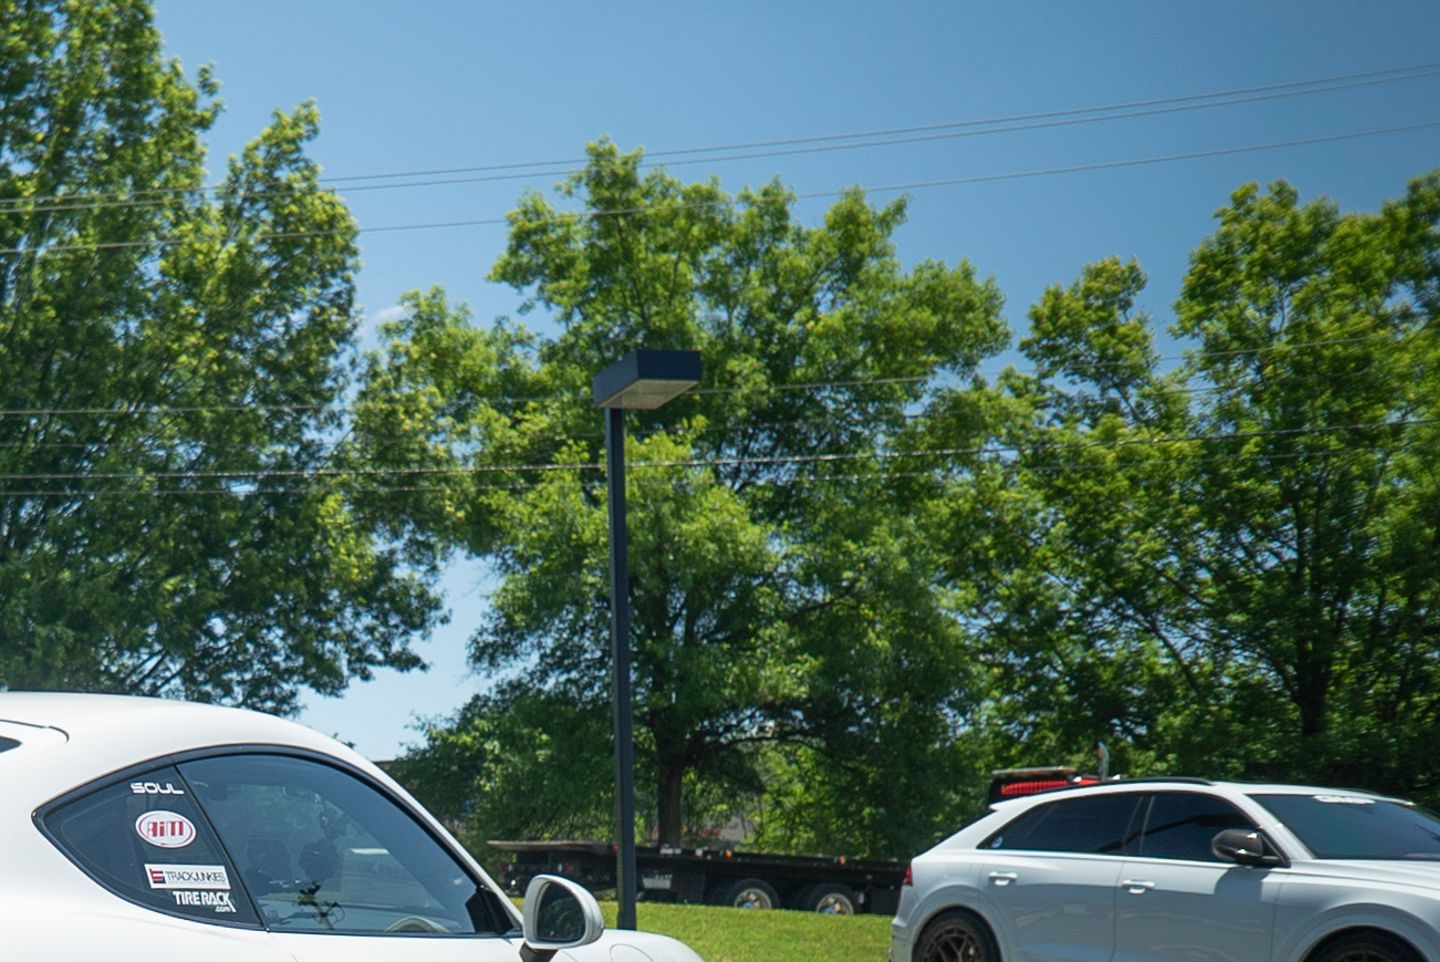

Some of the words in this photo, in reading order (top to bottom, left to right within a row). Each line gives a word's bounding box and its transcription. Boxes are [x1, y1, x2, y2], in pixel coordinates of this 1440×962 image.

[130, 782, 184, 794] SOUL
[172, 891, 200, 905] TIRE
[201, 891, 236, 912] RACK
